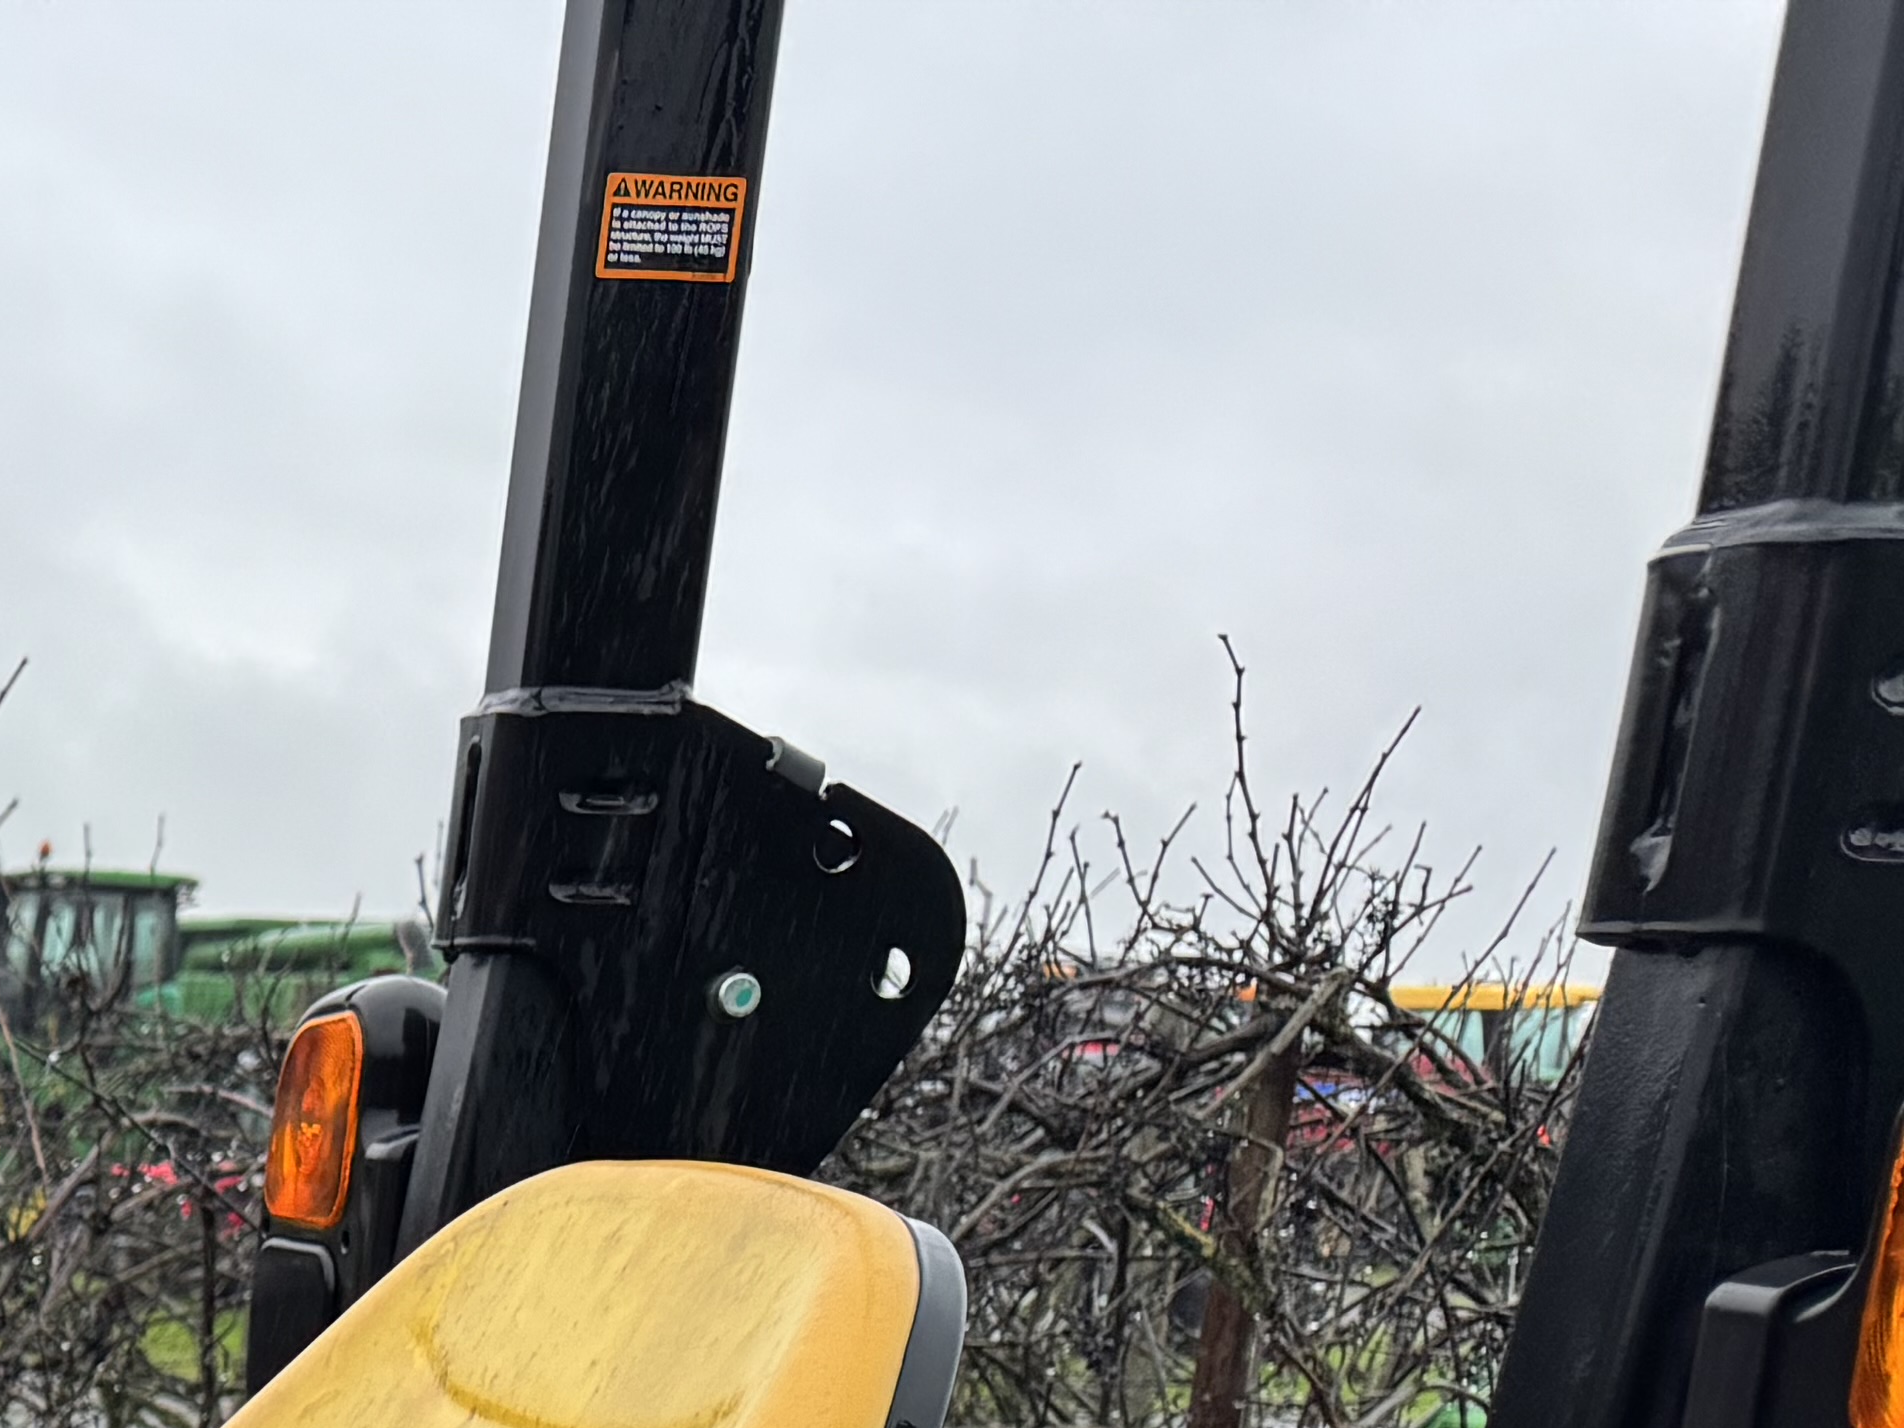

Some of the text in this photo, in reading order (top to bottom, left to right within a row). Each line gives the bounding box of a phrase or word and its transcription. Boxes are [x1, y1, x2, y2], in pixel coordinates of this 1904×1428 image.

[634, 178, 738, 202] WARNING
[630, 210, 666, 220] canopy
[699, 223, 728, 233] ROPS
